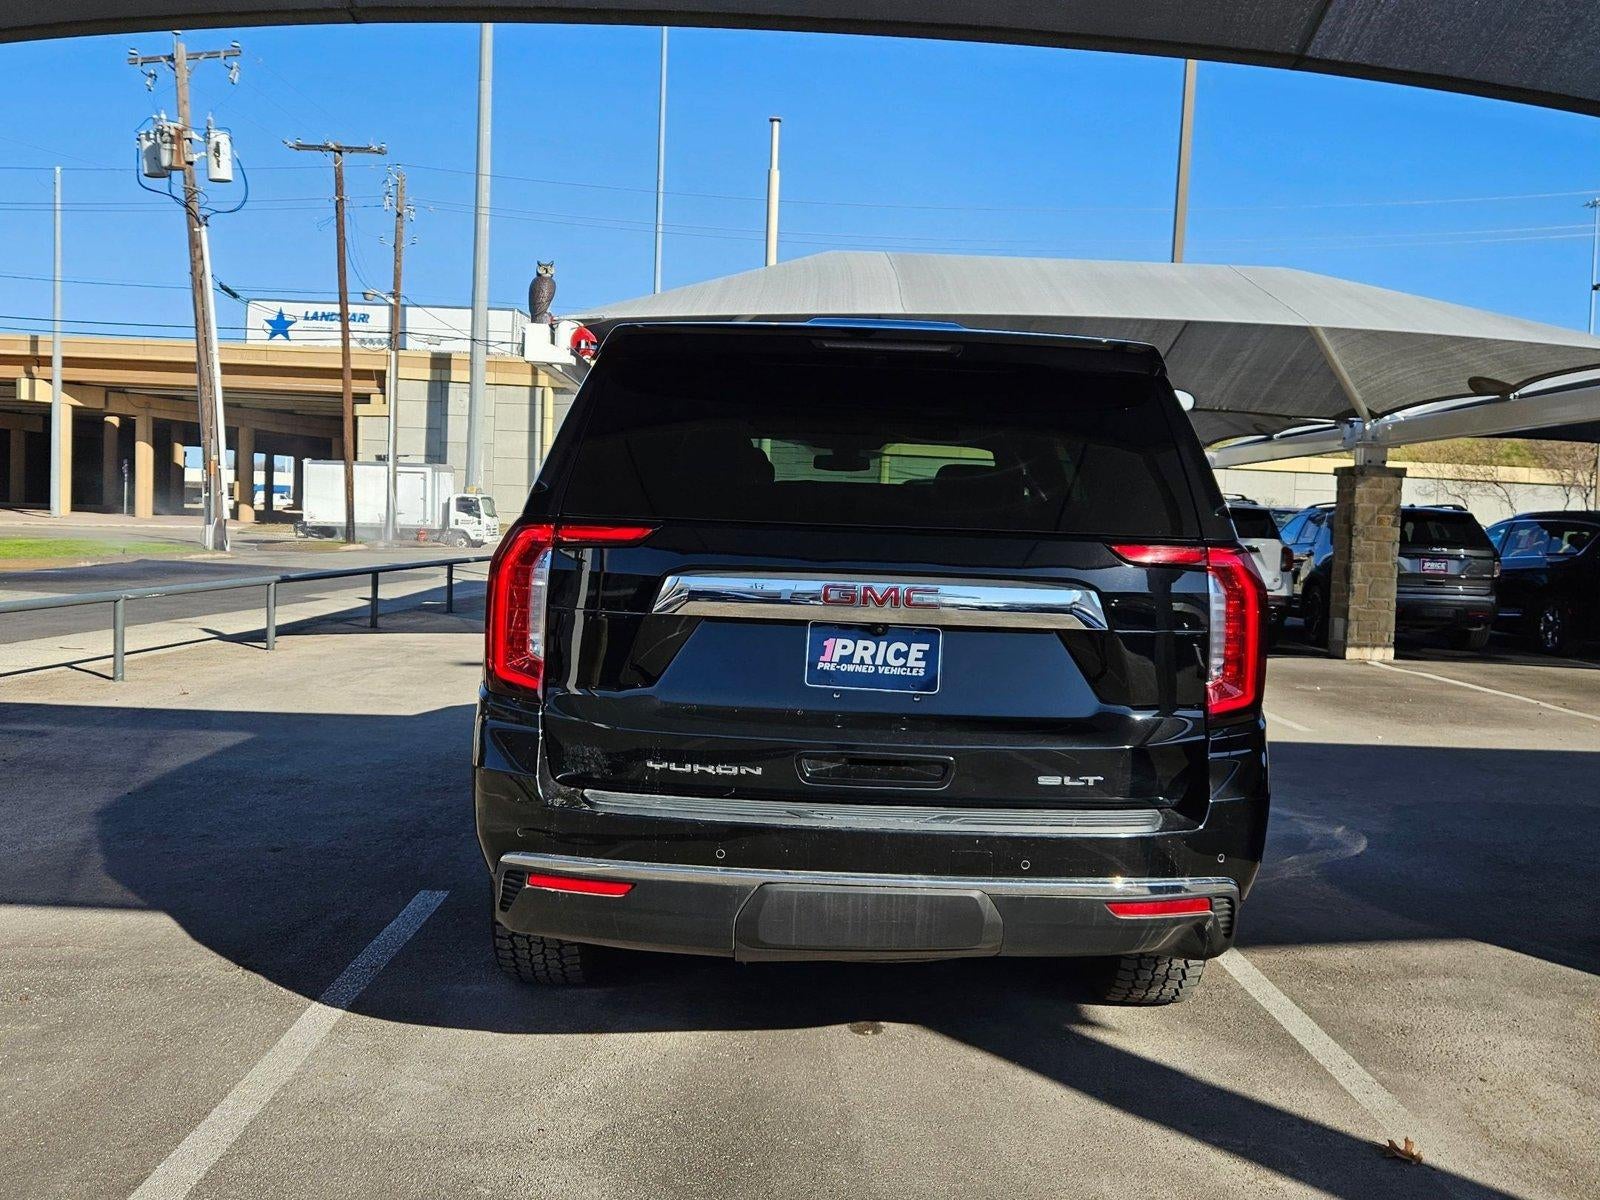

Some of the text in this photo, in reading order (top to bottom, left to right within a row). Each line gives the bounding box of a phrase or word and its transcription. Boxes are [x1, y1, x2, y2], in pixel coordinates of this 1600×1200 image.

[821, 583, 941, 609] GMC
[819, 638, 930, 668] 1PRICE
[817, 662, 925, 677] PRE-OWNED VEHICLES
[646, 760, 763, 776] YUKON
[1037, 775, 1105, 786] SLT
